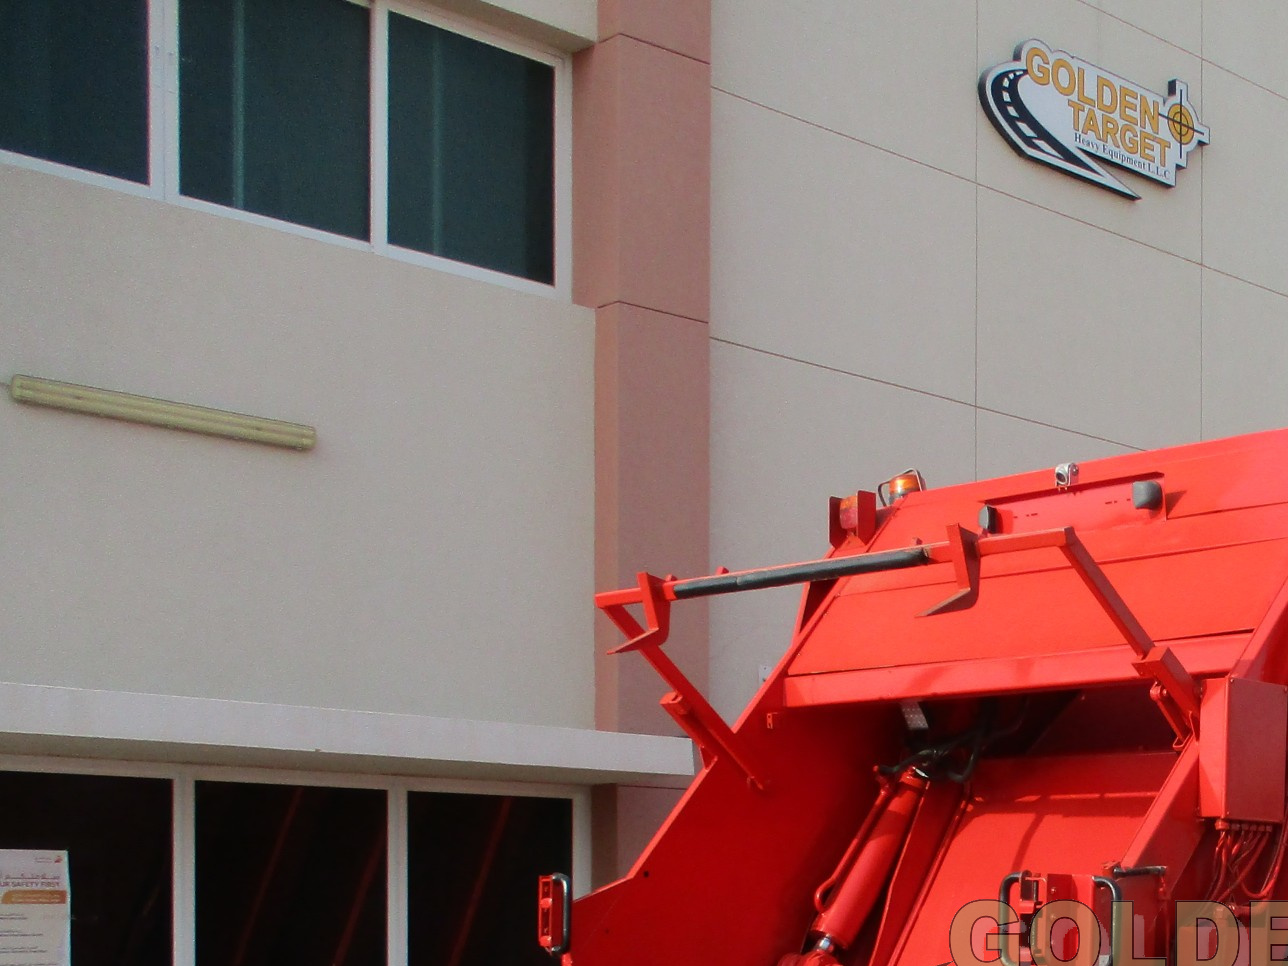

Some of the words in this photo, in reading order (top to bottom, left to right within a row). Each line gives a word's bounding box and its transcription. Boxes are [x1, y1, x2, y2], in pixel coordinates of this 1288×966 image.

[1026, 47, 1160, 135] GOLDEN
[1068, 99, 1171, 167] TARGET
[1074, 132, 1100, 154] Heavy
[1103, 144, 1146, 170] Equipment
